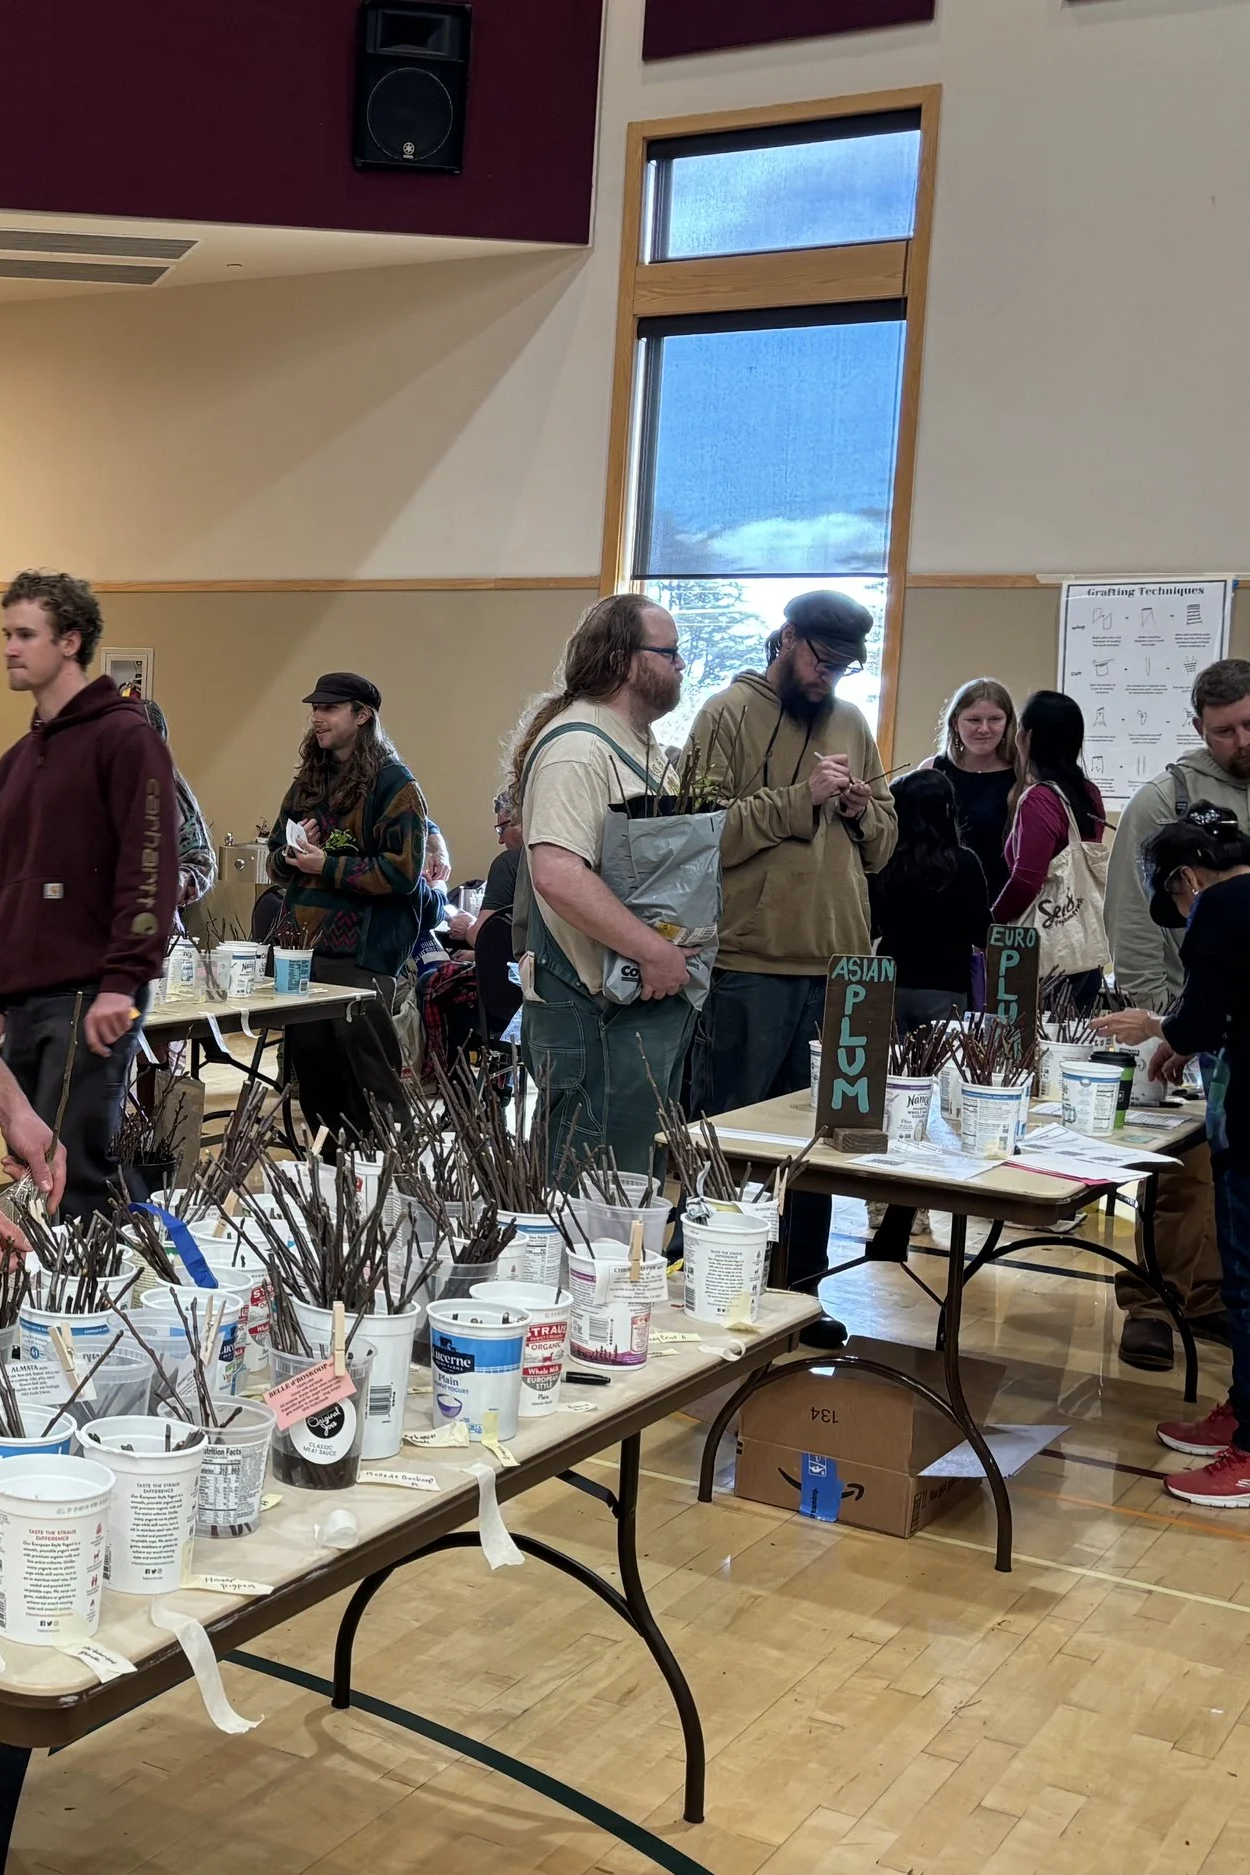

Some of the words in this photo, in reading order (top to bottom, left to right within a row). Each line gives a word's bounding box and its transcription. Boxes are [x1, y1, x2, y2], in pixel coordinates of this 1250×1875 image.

[1087, 587, 1135, 598] Grafting
[1138, 586, 1205, 597] Techniques
[136, 778, 162, 908] carhartt
[990, 926, 1036, 948] EURO
[831, 956, 896, 983] ASIAN
[831, 984, 870, 1113] PLUM
[526, 1325, 566, 1337] STRAUS
[531, 1342, 561, 1350] ORGANIC
[528, 1366, 549, 1375] Whole
[438, 1373, 460, 1387] Plain
[268, 1384, 291, 1398] BELLE
[307, 1406, 341, 1428] Original
[810, 1406, 839, 1424] 134
[203, 1447, 225, 1456] utrition
[226, 1447, 242, 1456] Facts
[303, 1446, 318, 1454] MEAT
[318, 1449, 337, 1457] SAUCE
[309, 1442, 333, 1450] CLASSIC
